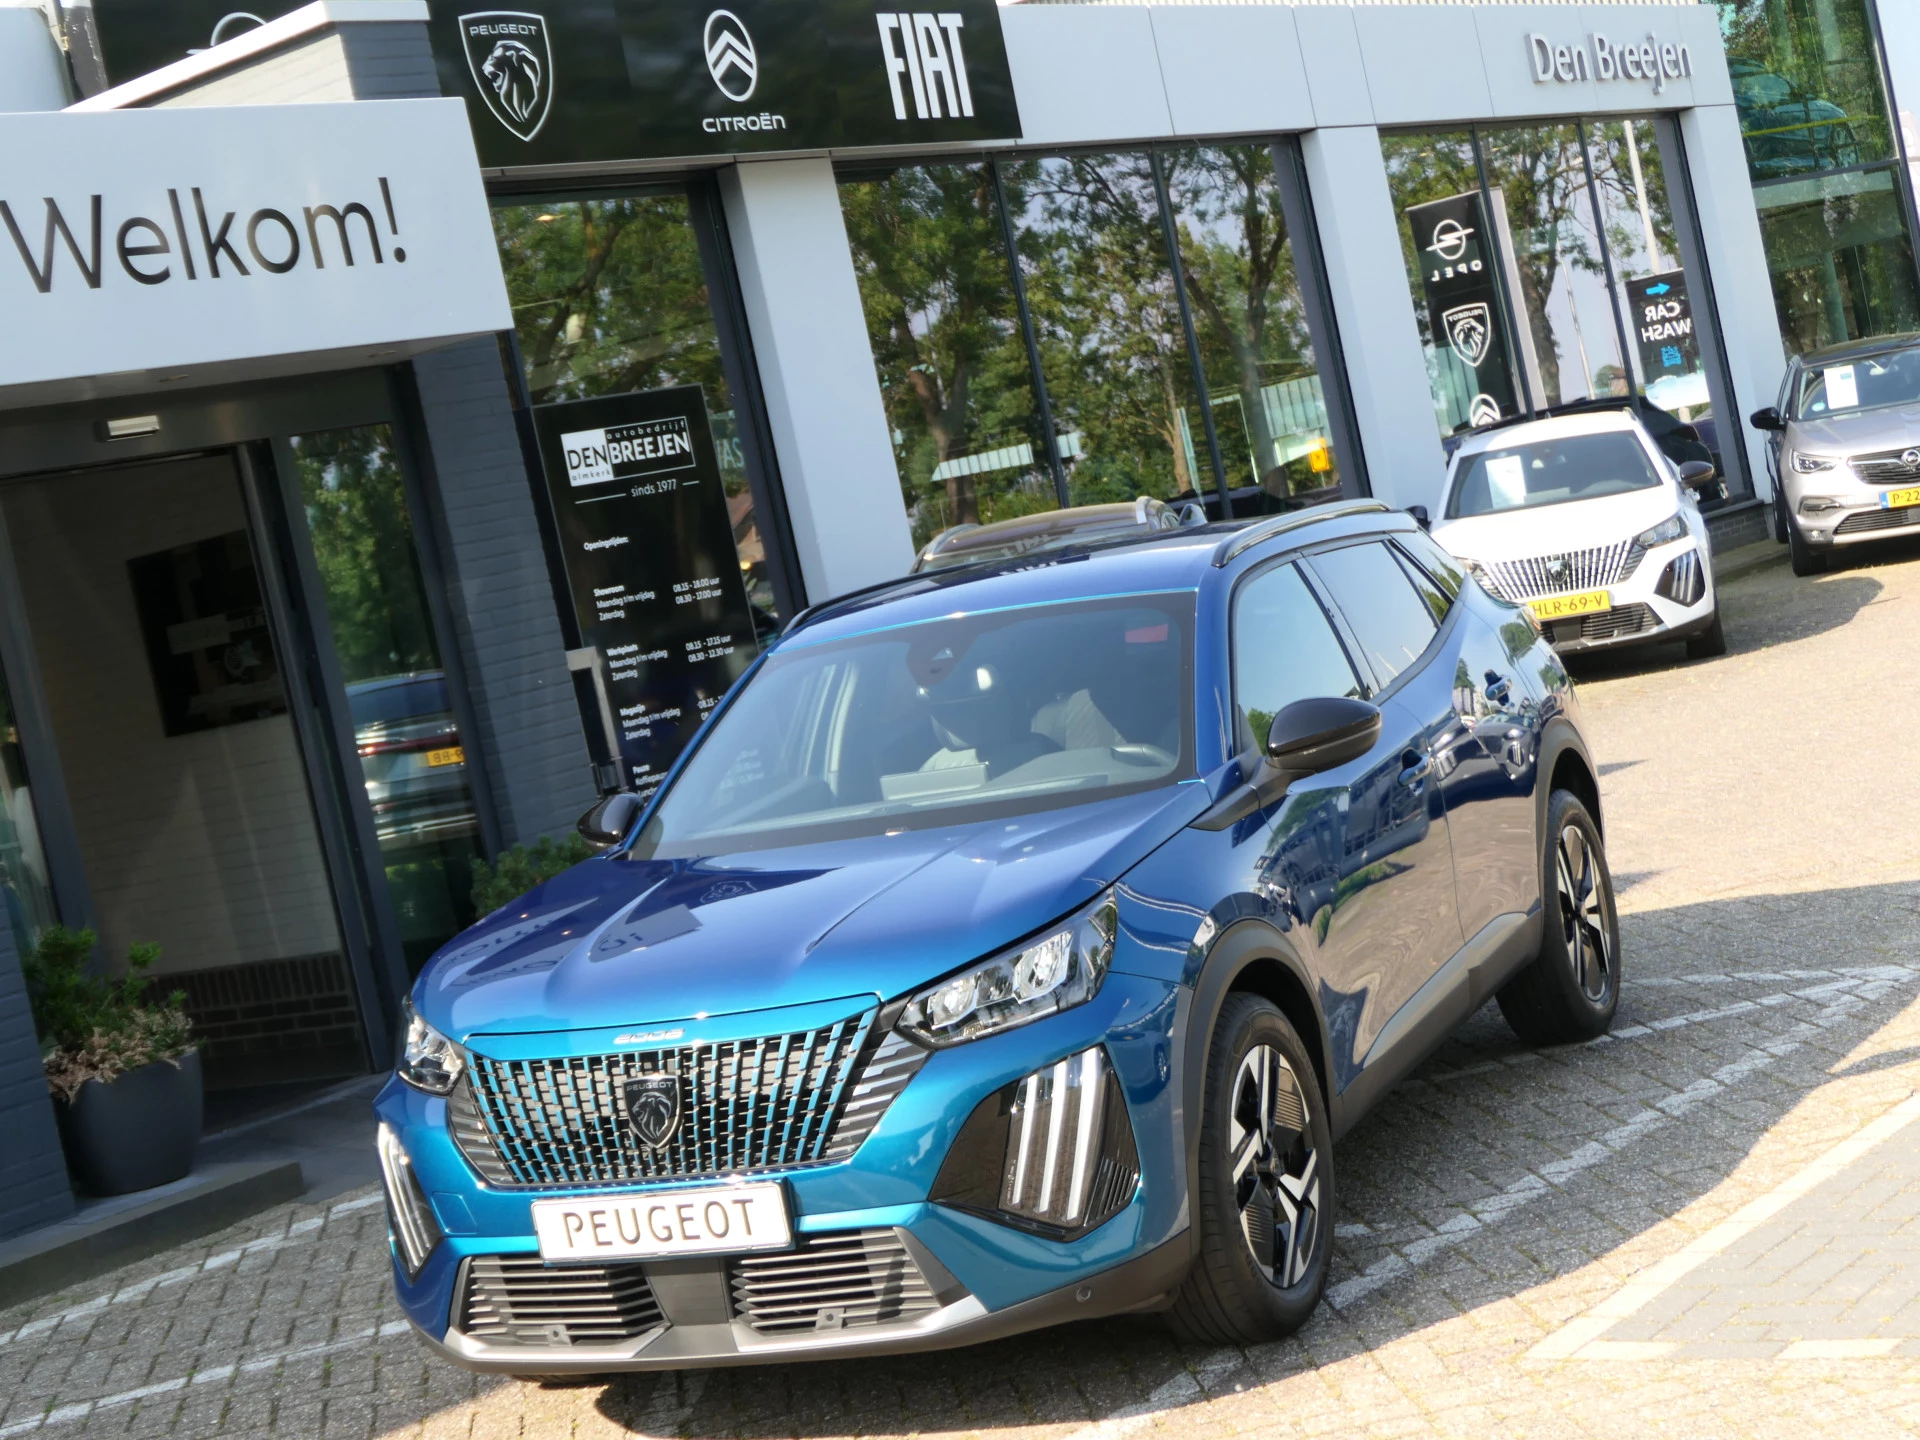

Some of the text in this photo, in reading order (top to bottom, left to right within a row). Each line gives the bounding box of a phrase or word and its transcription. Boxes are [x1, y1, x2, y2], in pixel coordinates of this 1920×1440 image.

[469, 23, 538, 38] PEUGEOT
[876, 13, 975, 120] FIAT
[1525, 30, 1694, 95] Den Breejen
[0, 176, 408, 294] Welkom!
[606, 420, 685, 440] autobedrijf
[567, 432, 690, 470] DEN BREEJEN
[572, 468, 611, 481] almkerk
[631, 479, 677, 497] sinds 1977
[709, 577, 720, 585] uur
[593, 585, 625, 597] Showroom
[711, 589, 722, 597] uur
[1532, 594, 1603, 616] HLR-69-V
[720, 635, 731, 643] uur
[723, 646, 734, 654] uur
[627, 1081, 673, 1091] PEUGEOT
[562, 1198, 754, 1249] PEUGEOT
